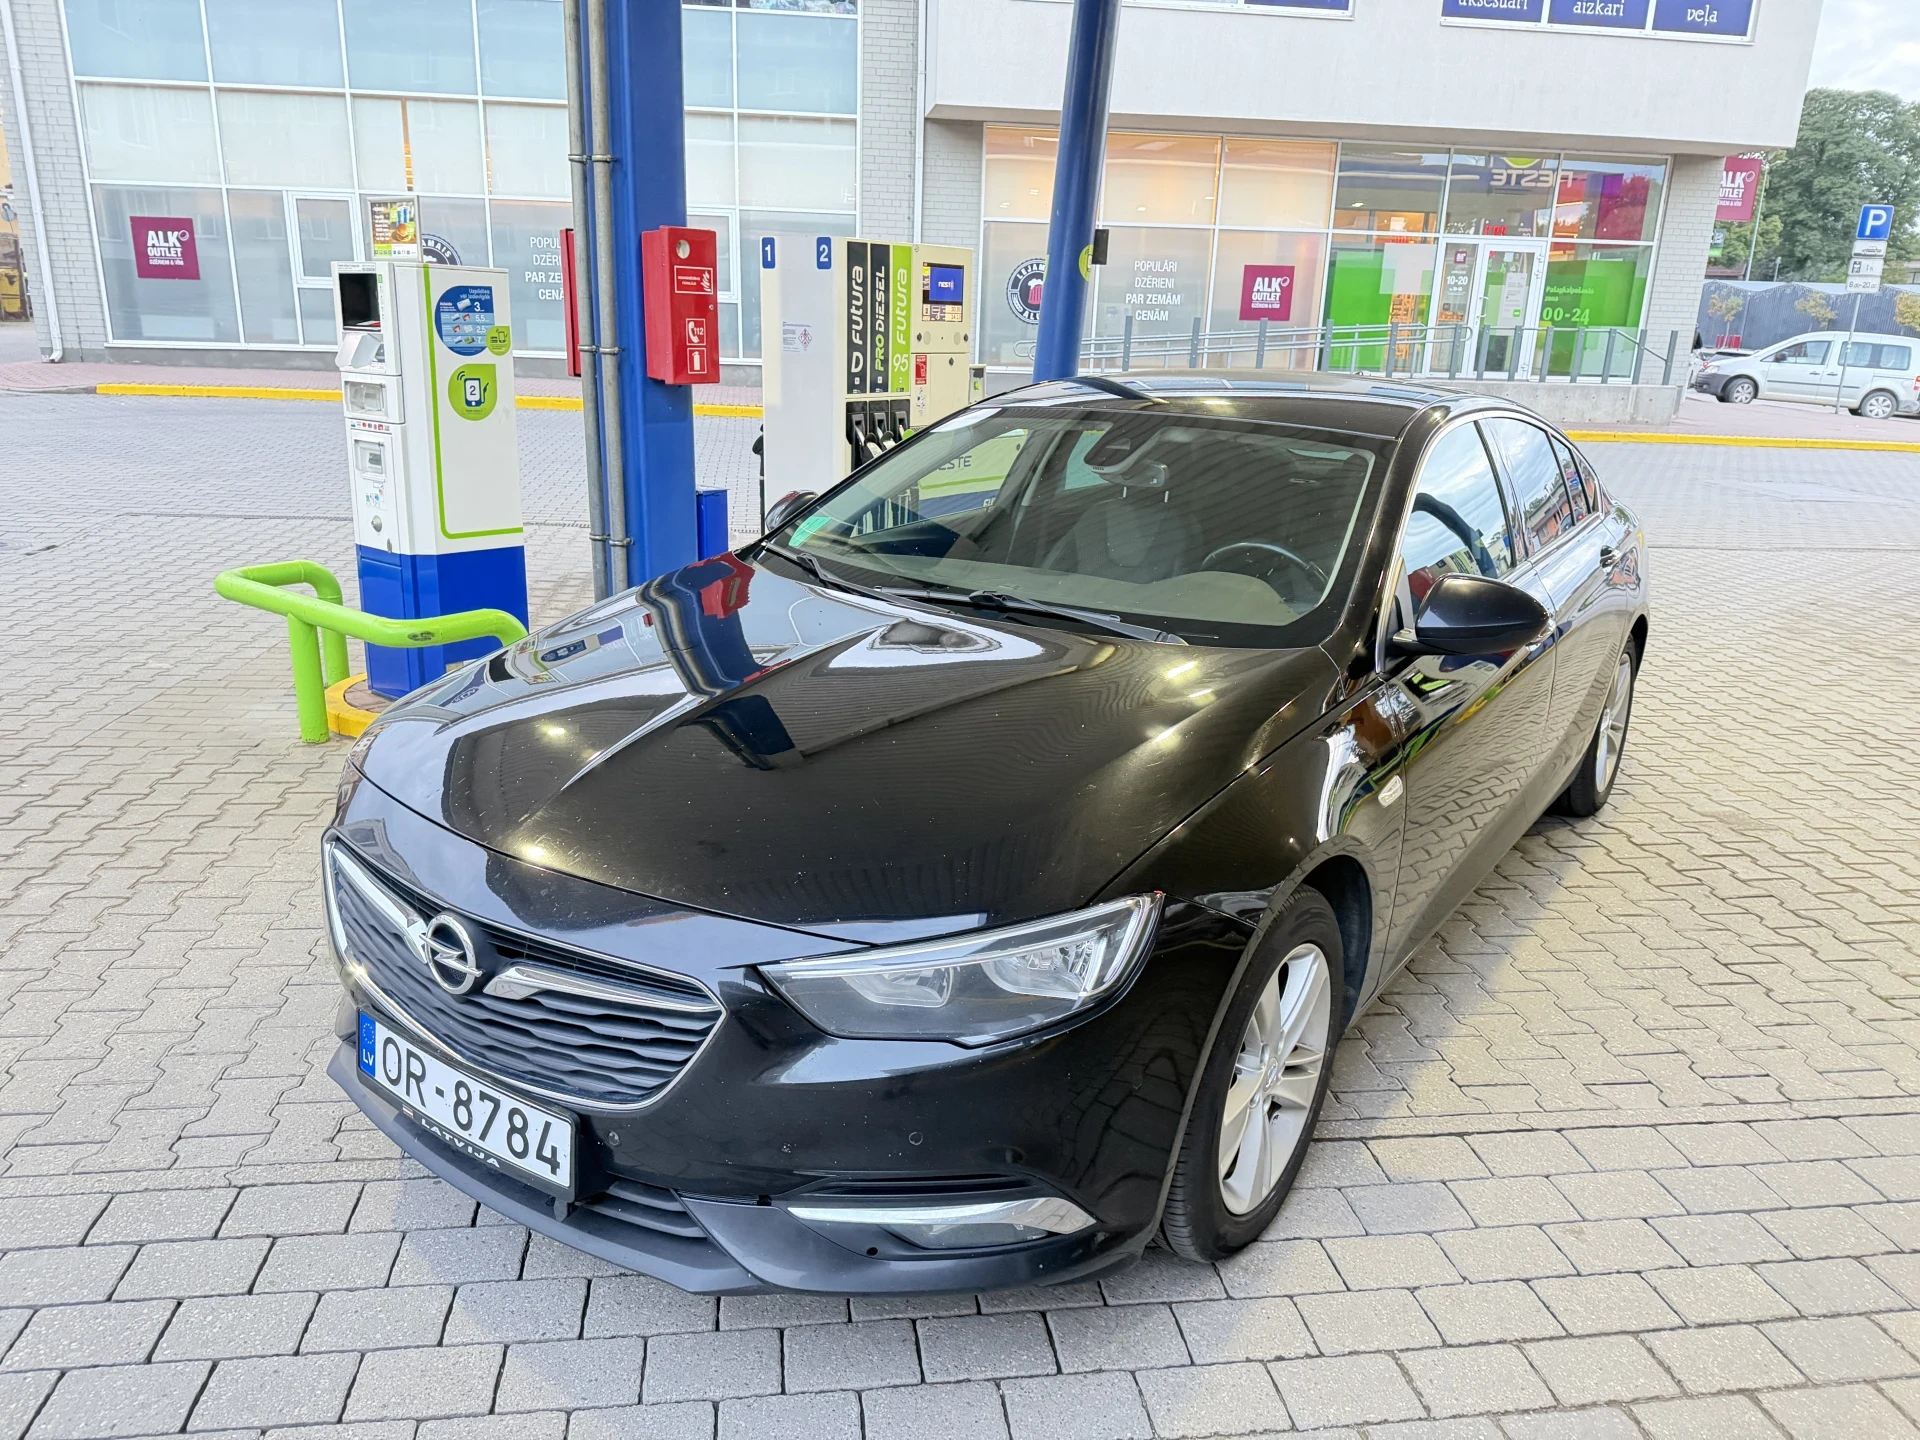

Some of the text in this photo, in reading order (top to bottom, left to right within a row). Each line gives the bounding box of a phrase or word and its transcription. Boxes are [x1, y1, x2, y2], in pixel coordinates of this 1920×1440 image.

[1573, 0, 1624, 16] aizkari
[1687, 4, 1718, 26] veļa
[1719, 187, 1744, 199] UTLET
[1865, 209, 1887, 236] P
[147, 230, 181, 247] ALK
[530, 237, 561, 249] POPUL
[147, 247, 182, 257] OUTLET
[421, 239, 452, 258] AMAIS
[765, 244, 771, 262] 1
[819, 244, 829, 262] 2
[1134, 259, 1178, 272] POPULĀRI
[525, 271, 546, 283] PAR
[1134, 275, 1175, 289] DZĒRIENI
[1253, 277, 1281, 292] ALK
[1447, 275, 1468, 285] 10-20
[538, 287, 564, 301] CENĀ
[1125, 292, 1181, 306] PAR ZEMĀM
[1252, 292, 1280, 301] OUTLET
[474, 301, 481, 312] 3
[1135, 308, 1169, 321] CENĀM
[1543, 306, 1591, 326] 00-24
[693, 327, 704, 336] 112
[875, 333, 885, 371] PRO
[851, 351, 864, 373] D
[893, 353, 909, 372] 95
[469, 385, 477, 396] 2
[361, 1048, 375, 1067] LV
[382, 1036, 561, 1177] OR-8784
[421, 1118, 501, 1169] LATVIJA
